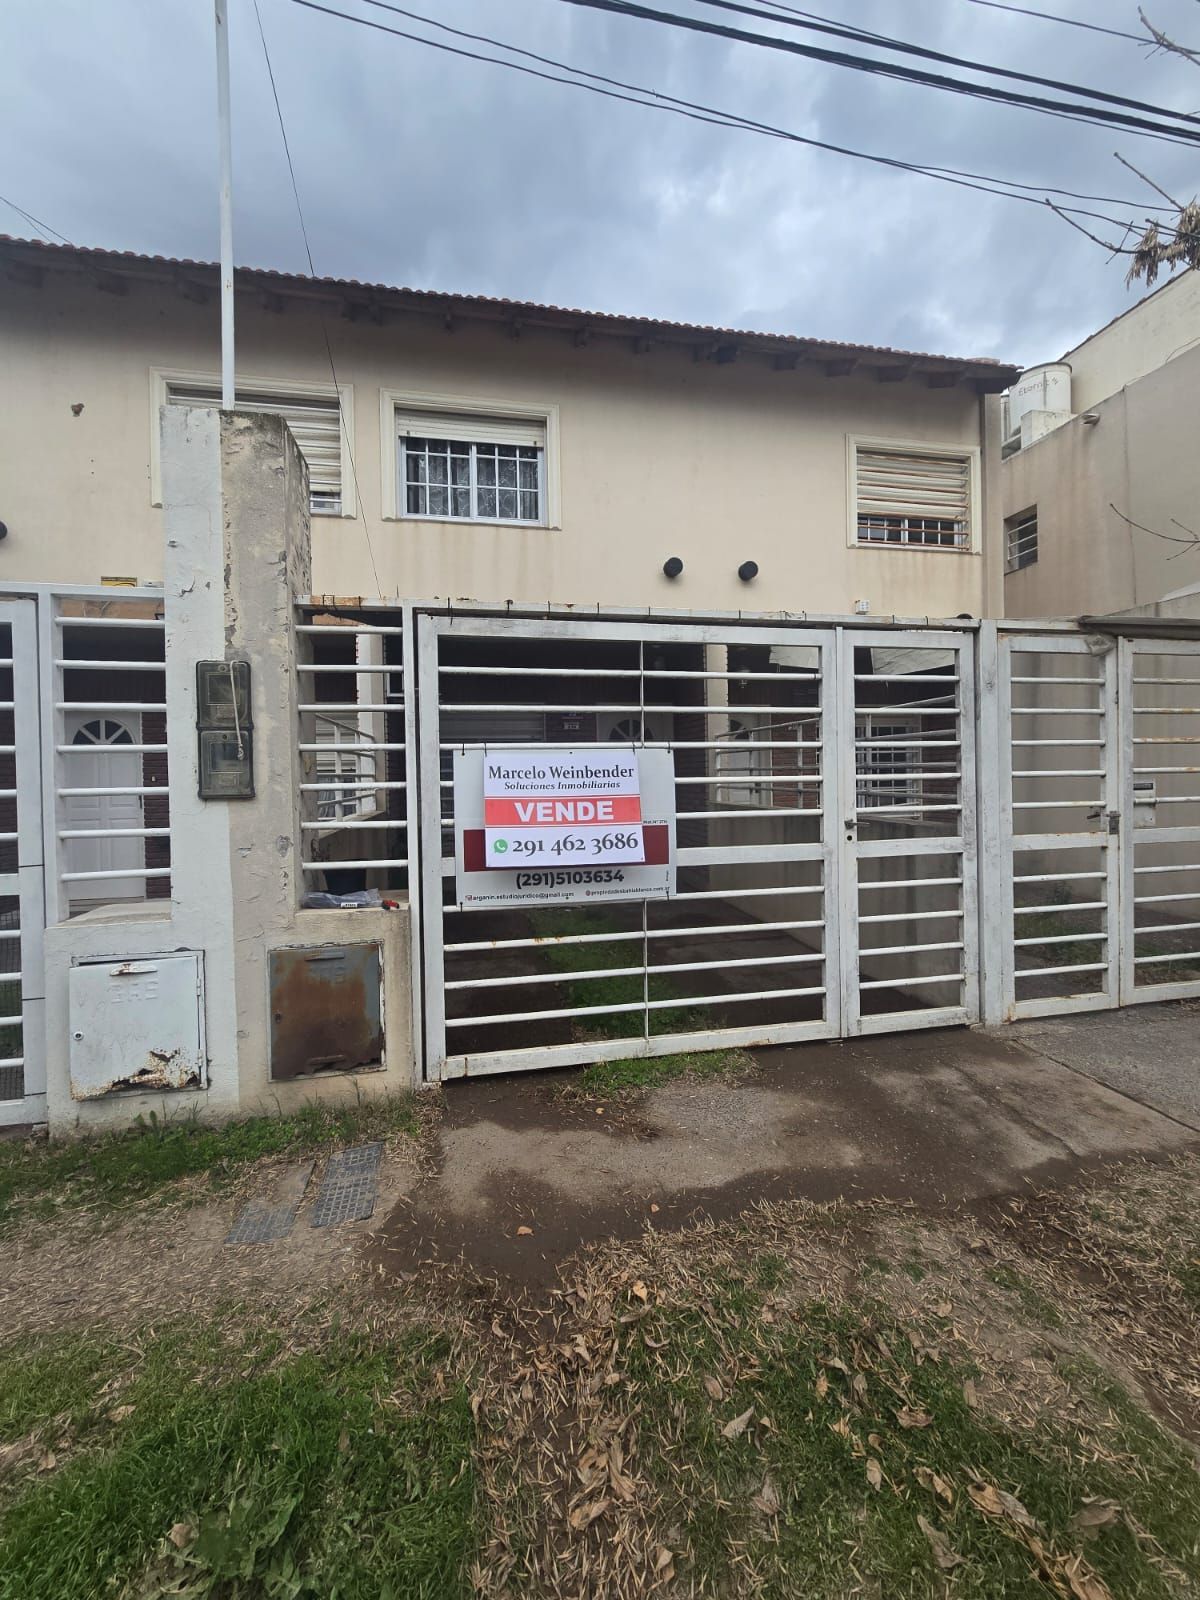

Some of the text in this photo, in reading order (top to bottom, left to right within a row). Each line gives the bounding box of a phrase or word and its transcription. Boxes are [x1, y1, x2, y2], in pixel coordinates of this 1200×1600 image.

[488, 764, 635, 780] Marcelo Weinbender
[504, 780, 620, 790] Soluciones Inmobiliarias
[514, 800, 614, 823] VENDE
[512, 832, 639, 856] 291 462 3686
[515, 869, 625, 889] (291)5103634
